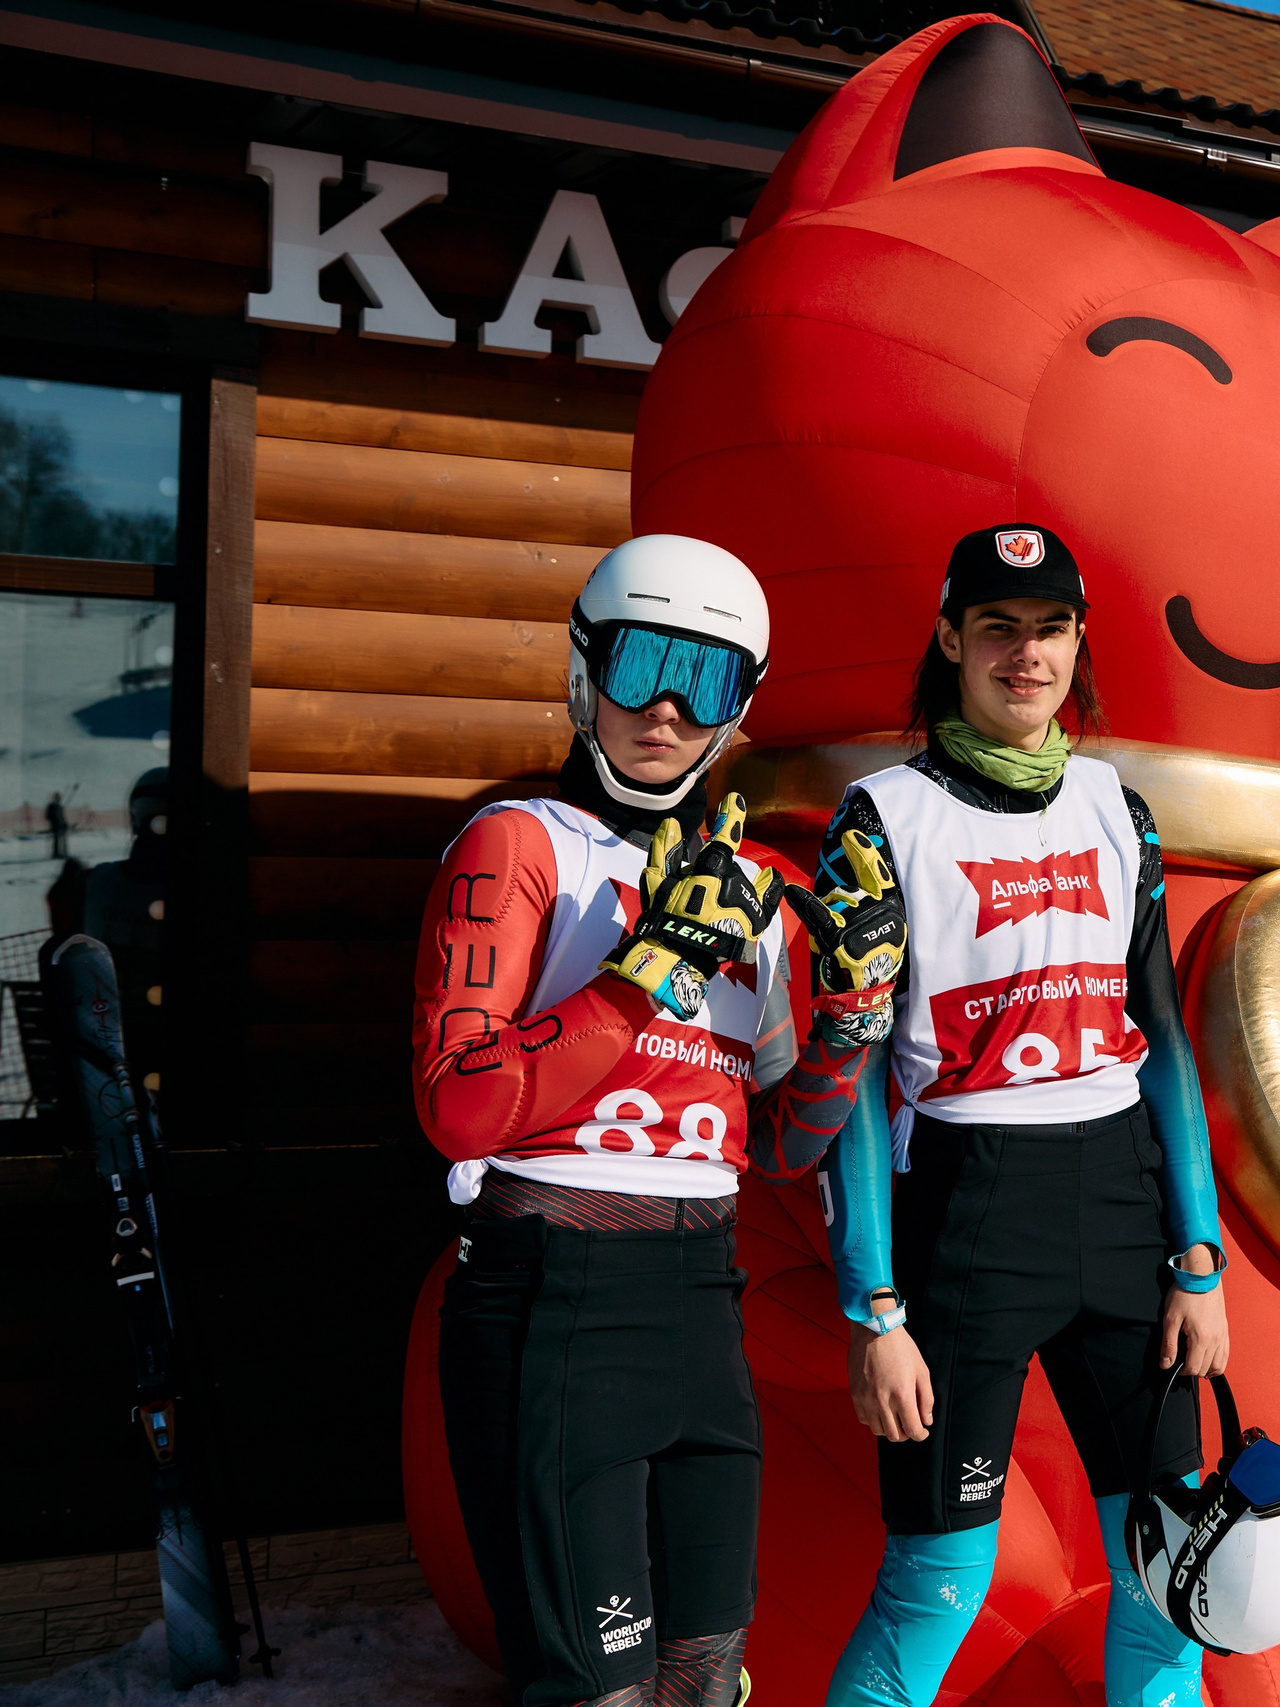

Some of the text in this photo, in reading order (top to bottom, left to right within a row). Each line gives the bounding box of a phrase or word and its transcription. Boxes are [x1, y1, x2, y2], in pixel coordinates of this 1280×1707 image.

[245, 141, 720, 371] КА
[569, 613, 589, 647] EAD
[740, 884, 763, 918] LEVEL
[991, 874, 1053, 900] Альфа
[663, 920, 718, 946] LEKI
[862, 921, 896, 941] LEVEL
[964, 973, 1082, 1020] СТАРТОВЫЙ
[710, 1049, 752, 1082] НОМ
[574, 1088, 728, 1162] 88
[959, 1488, 992, 1502] REBELS
[961, 1473, 1005, 1493] WORLDCUP
[1174, 1507, 1228, 1590] HEAD
[600, 1616, 652, 1644] WORLDCUP
[602, 1632, 643, 1655] REBELS
